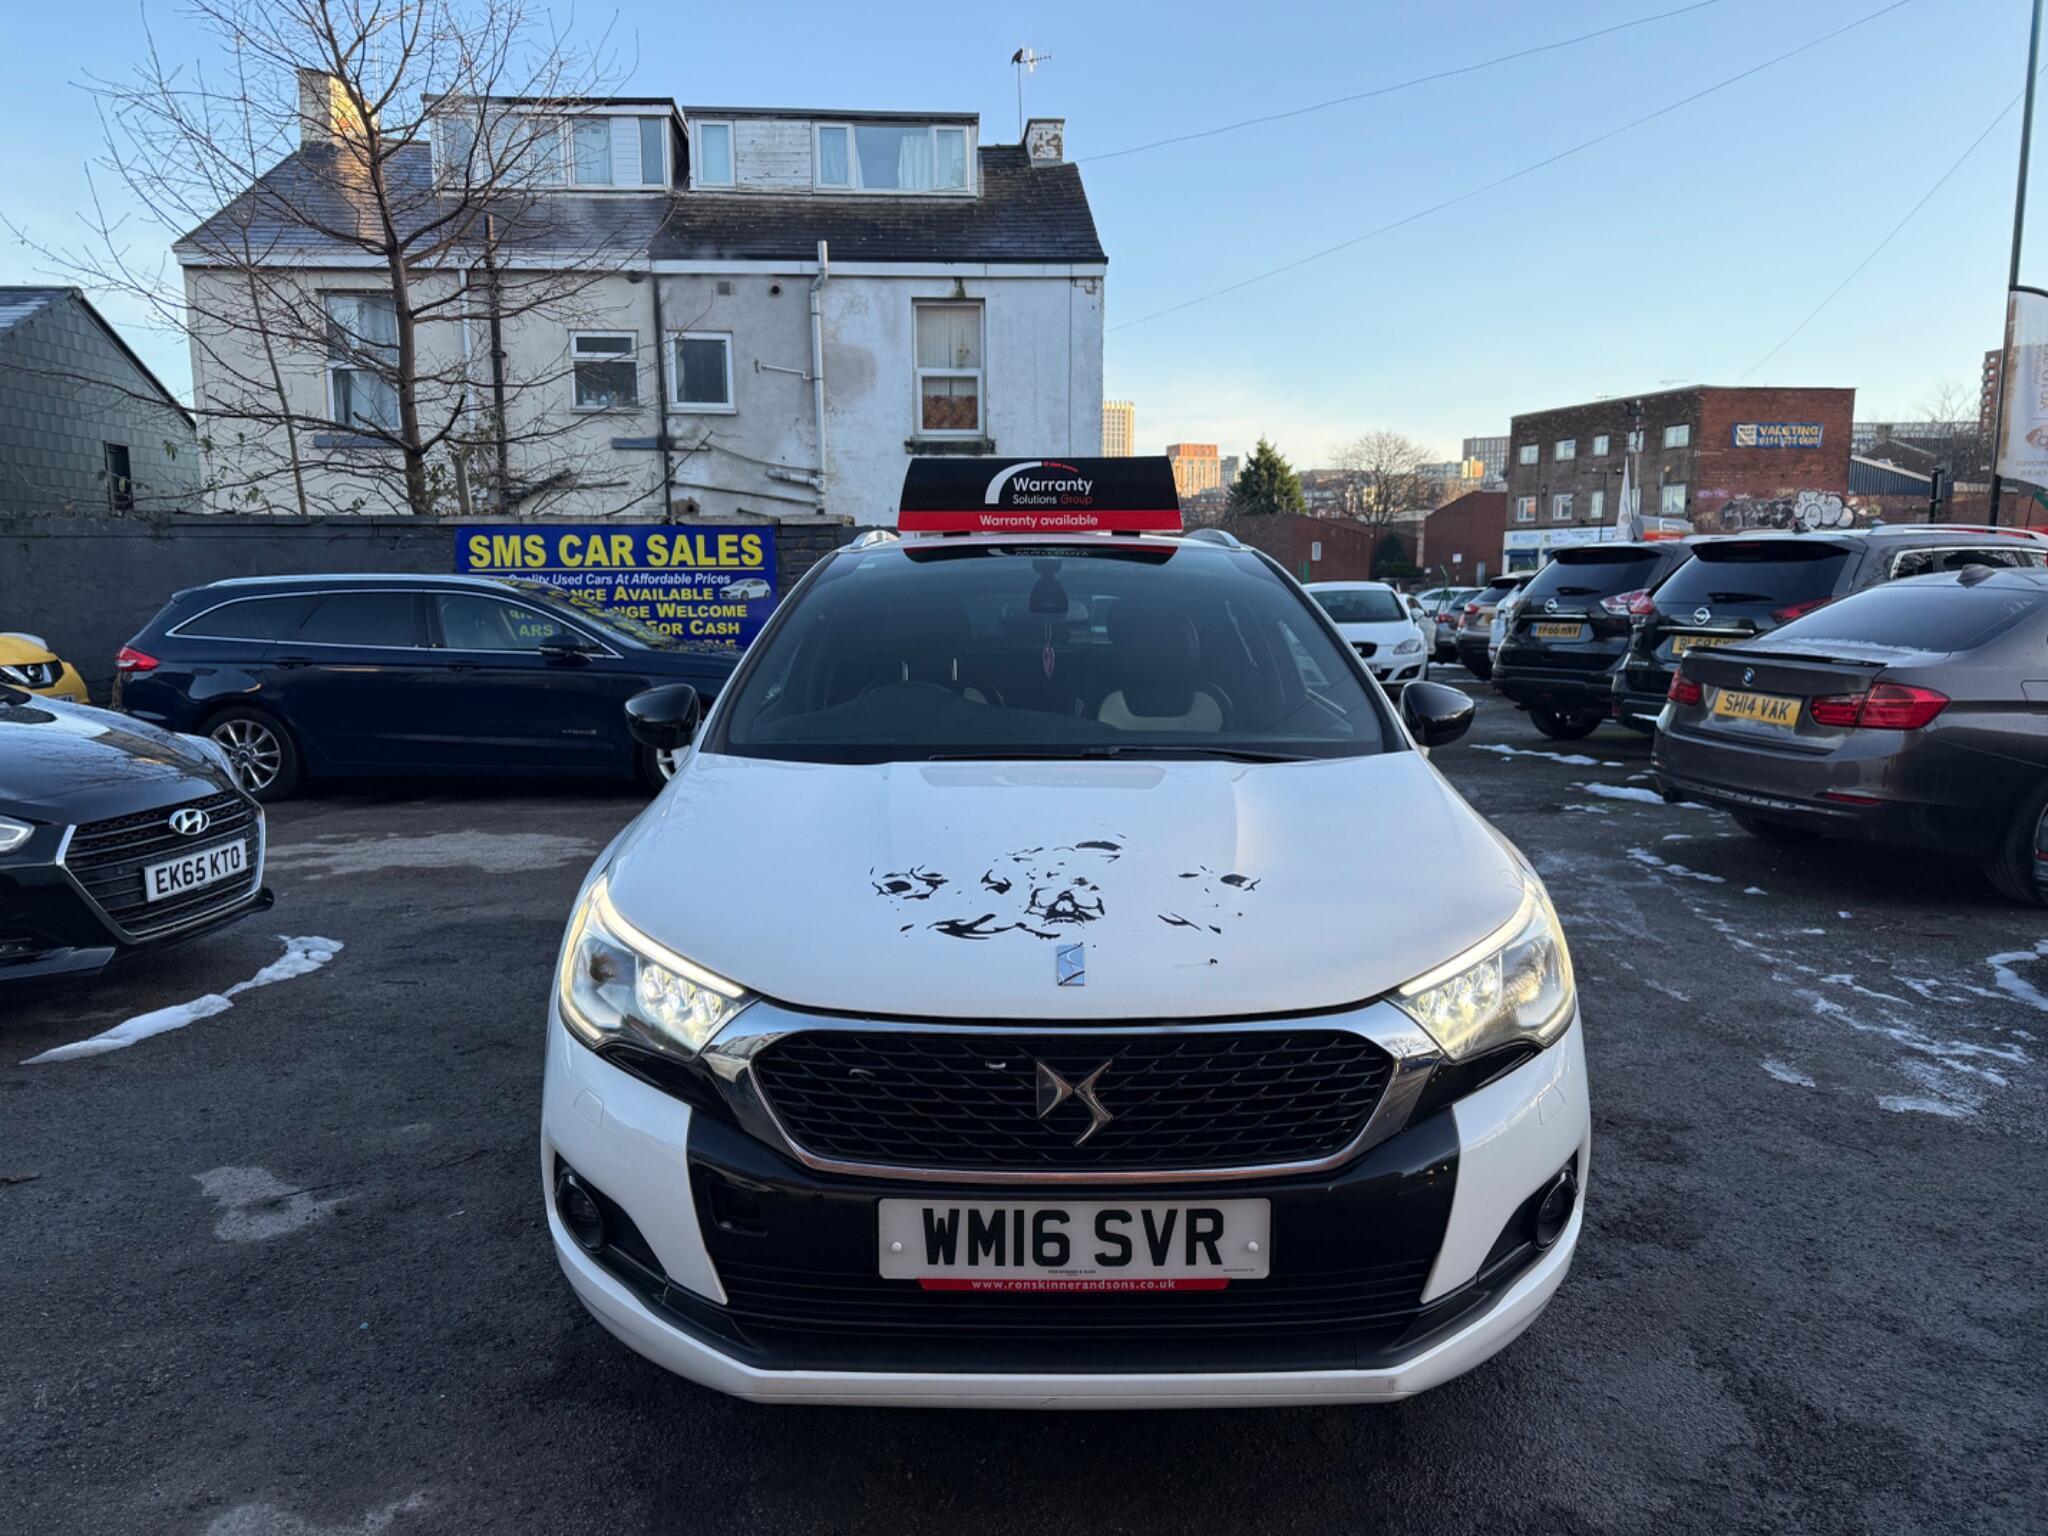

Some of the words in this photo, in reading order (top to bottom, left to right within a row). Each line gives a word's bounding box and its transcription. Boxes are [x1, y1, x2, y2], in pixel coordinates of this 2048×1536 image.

[1760, 426, 1819, 436] VALETING
[1012, 477, 1093, 495] Warranty
[1012, 493, 1058, 505] Solutions
[1060, 494, 1093, 506] Group
[979, 515, 1038, 528] Warranty
[1040, 514, 1098, 526] available
[468, 534, 547, 567] SMS
[558, 534, 636, 567] CAR
[646, 534, 763, 567] SALES
[552, 574, 581, 585] Used
[587, 574, 614, 585] Cars
[616, 574, 629, 585] At
[631, 573, 692, 585] Affordable
[694, 573, 731, 585] Prices
[613, 586, 714, 601] AVAILABLE
[656, 603, 748, 618] WELCOME
[690, 620, 740, 635] CASH
[1724, 693, 1757, 714] SH14
[1760, 698, 1791, 720] VAK
[155, 856, 206, 894] EK65
[922, 1208, 1071, 1266] WM16
[1094, 1208, 1224, 1266] SVR
[971, 1278, 1176, 1291] www.ronskinnerandsons.co.uk
